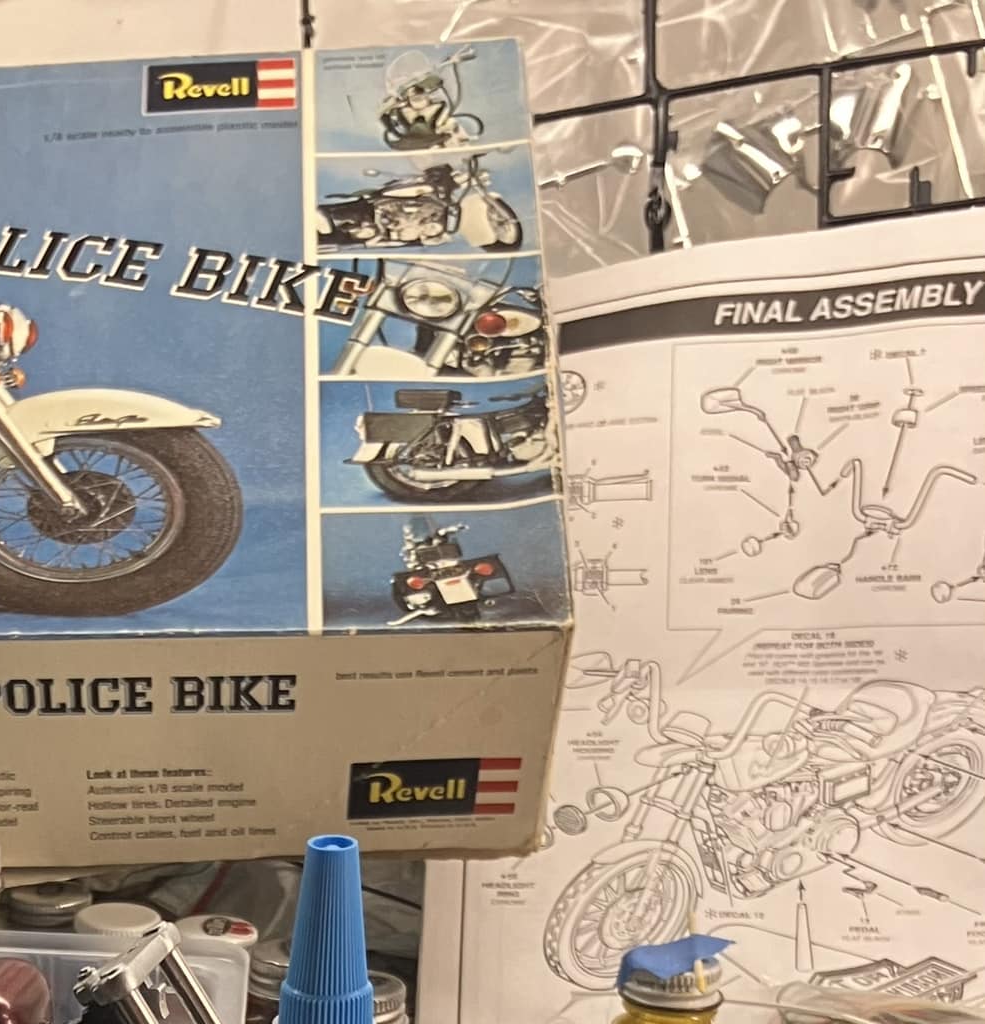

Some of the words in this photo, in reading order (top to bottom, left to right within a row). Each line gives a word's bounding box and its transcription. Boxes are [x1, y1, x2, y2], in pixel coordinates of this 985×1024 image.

[158, 72, 251, 100] Revell
[170, 246, 376, 325] BIKE
[714, 296, 803, 326] FINAL
[810, 280, 984, 322] ASSEMBLY
[171, 674, 297, 714] BIKE
[367, 772, 466, 804] Revell
